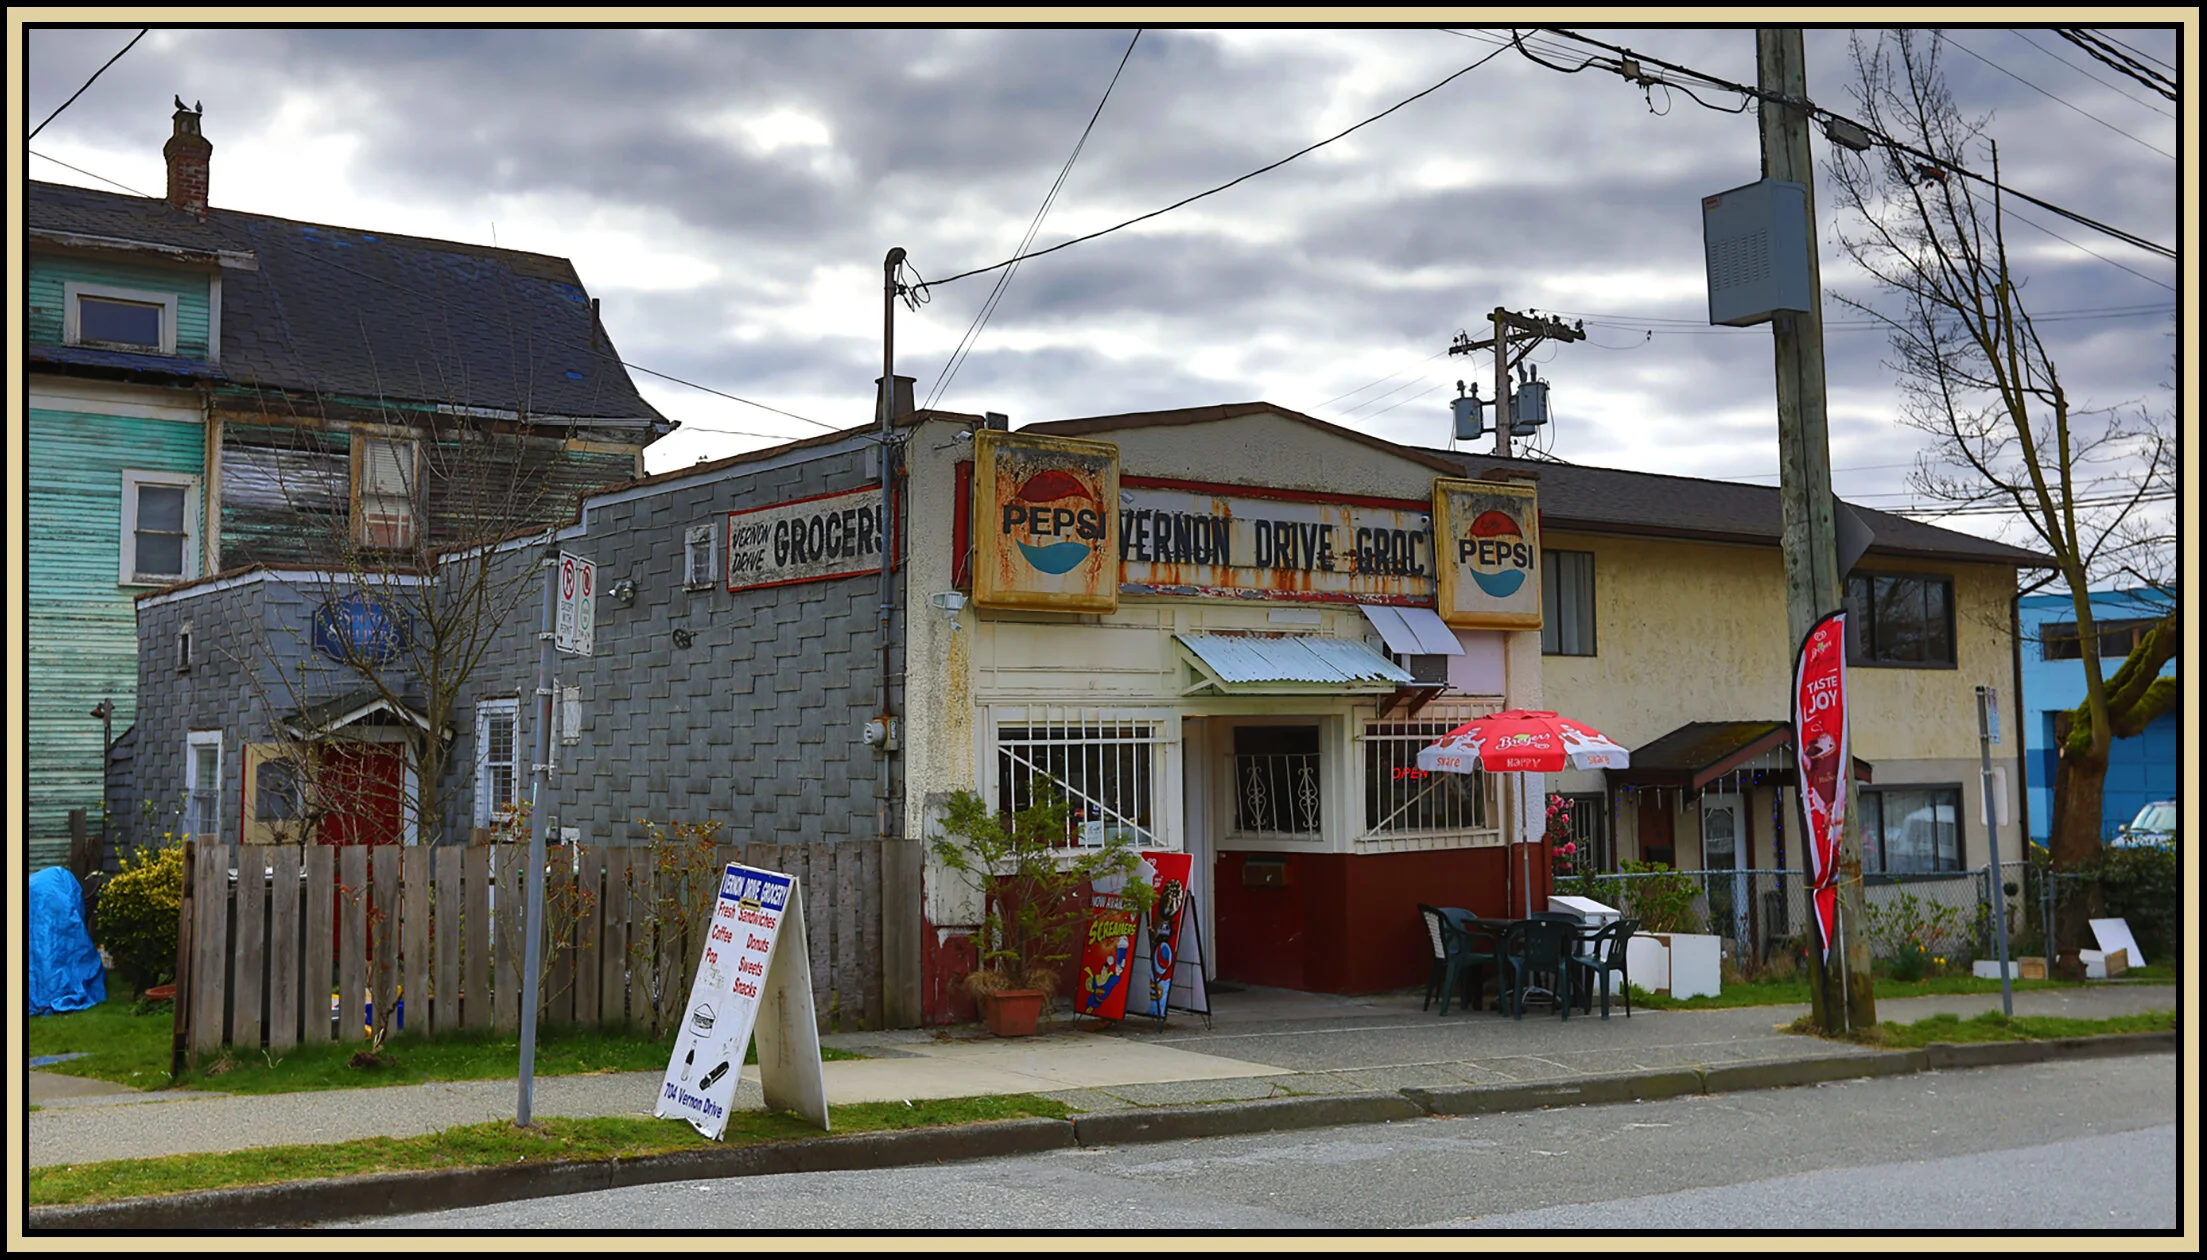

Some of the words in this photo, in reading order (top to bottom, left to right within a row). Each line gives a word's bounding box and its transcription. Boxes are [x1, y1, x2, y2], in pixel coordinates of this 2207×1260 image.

[1003, 505, 1107, 540] PEPSI
[733, 522, 773, 549] VERNON
[1119, 508, 1231, 565] VERNON
[1255, 519, 1335, 572] DRIVE
[1356, 527, 1425, 575] GROC
[732, 549, 766, 573] DRIVE
[1459, 539, 1534, 570] PEPSI
[1807, 676, 1838, 694] TASTE
[1808, 690, 1838, 715] JOY
[1496, 733, 1551, 751] Breyers
[1392, 766, 1429, 780] OPEN
[723, 873, 746, 898] VERNON
[743, 878, 763, 902] DRIVE
[760, 882, 788, 907] GROCERY
[717, 901, 736, 920] Fresh
[738, 908, 776, 930] Sandwiches
[711, 924, 733, 943] Coffee
[746, 933, 769, 953] Donuts
[1088, 920, 1137, 945] SCREAMERS
[705, 947, 718, 964] Pop
[738, 956, 763, 977] Sweets
[733, 977, 757, 998] Snacks
[664, 1082, 679, 1100] 704
[678, 1089, 702, 1112] Vernon
[703, 1098, 723, 1119] Drive
